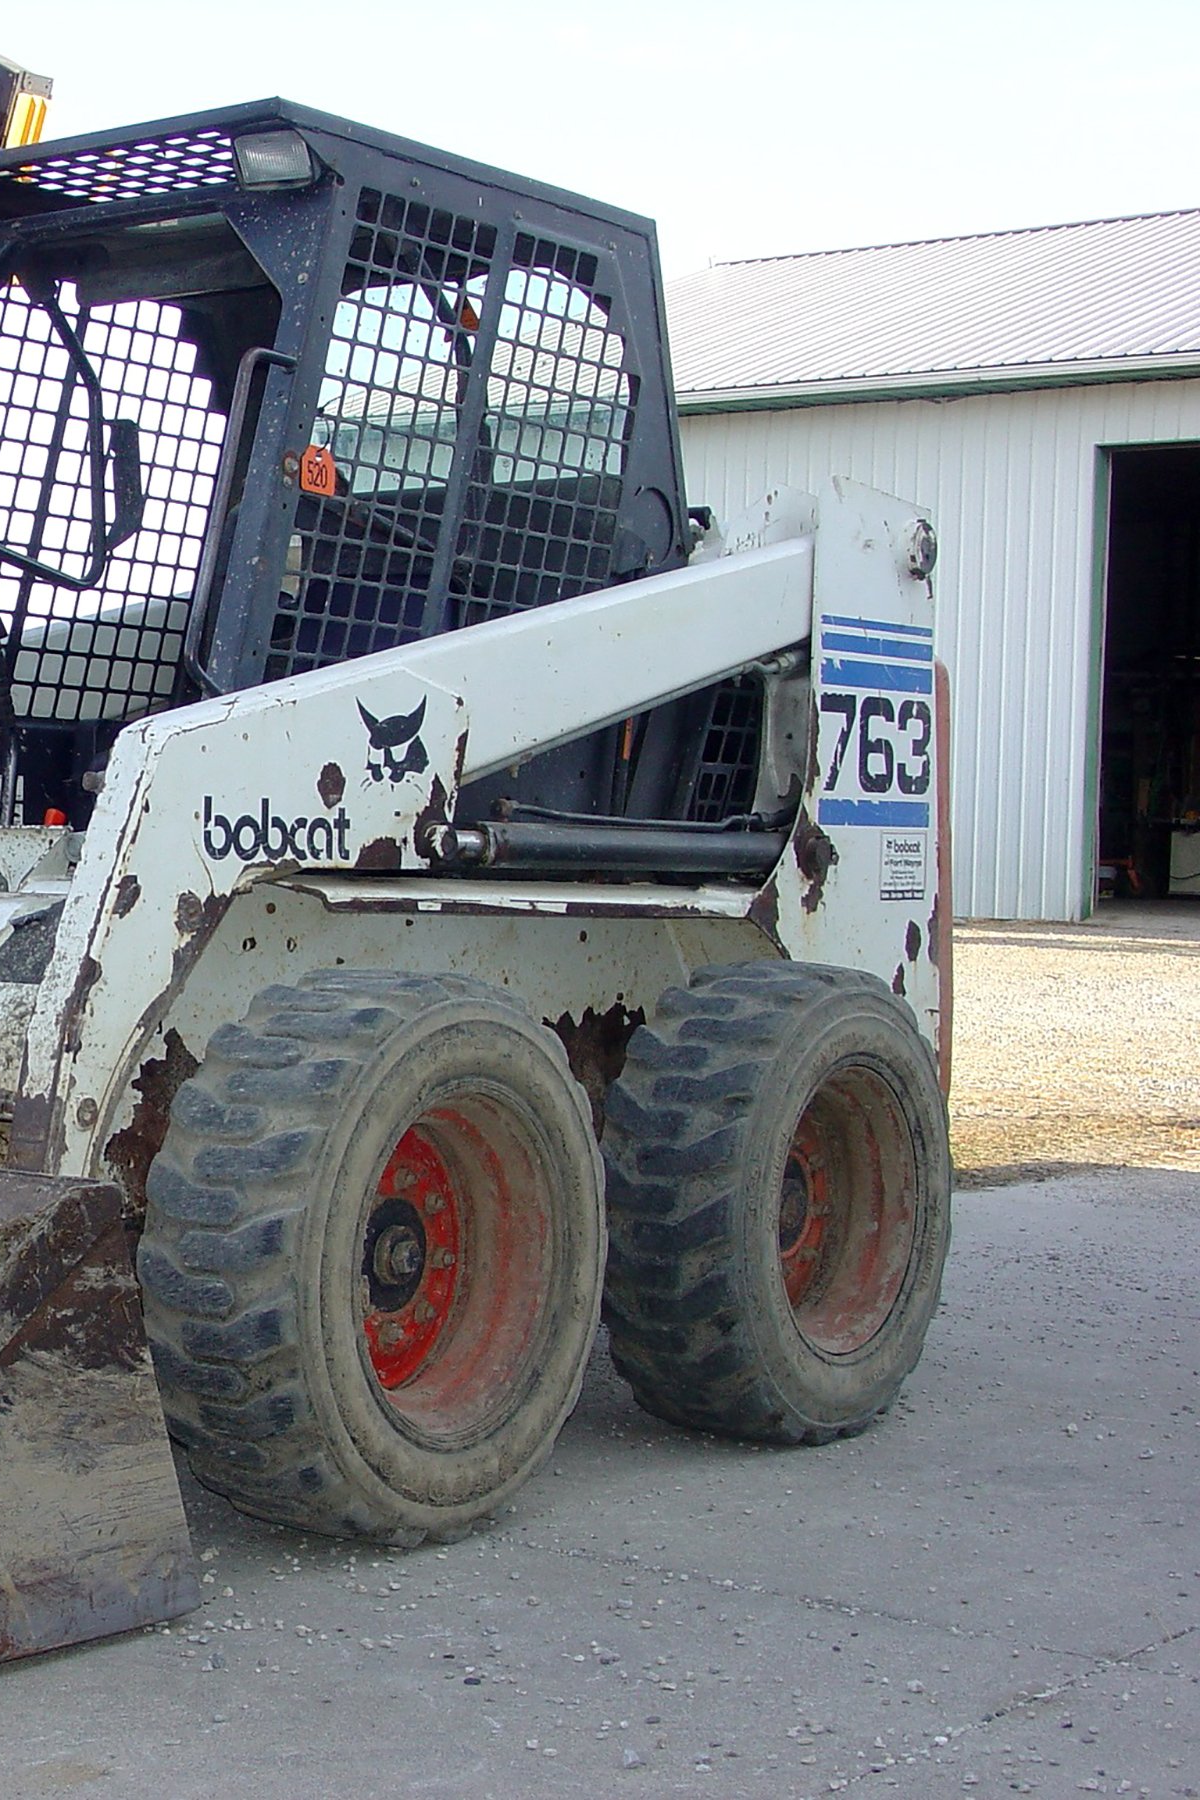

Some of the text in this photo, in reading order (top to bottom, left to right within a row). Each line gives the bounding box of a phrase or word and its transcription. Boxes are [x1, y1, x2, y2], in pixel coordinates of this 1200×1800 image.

[307, 460, 327, 488] 520
[820, 692, 932, 796] 763
[203, 796, 351, 861] bobcat
[894, 839, 920, 853] bobcat
